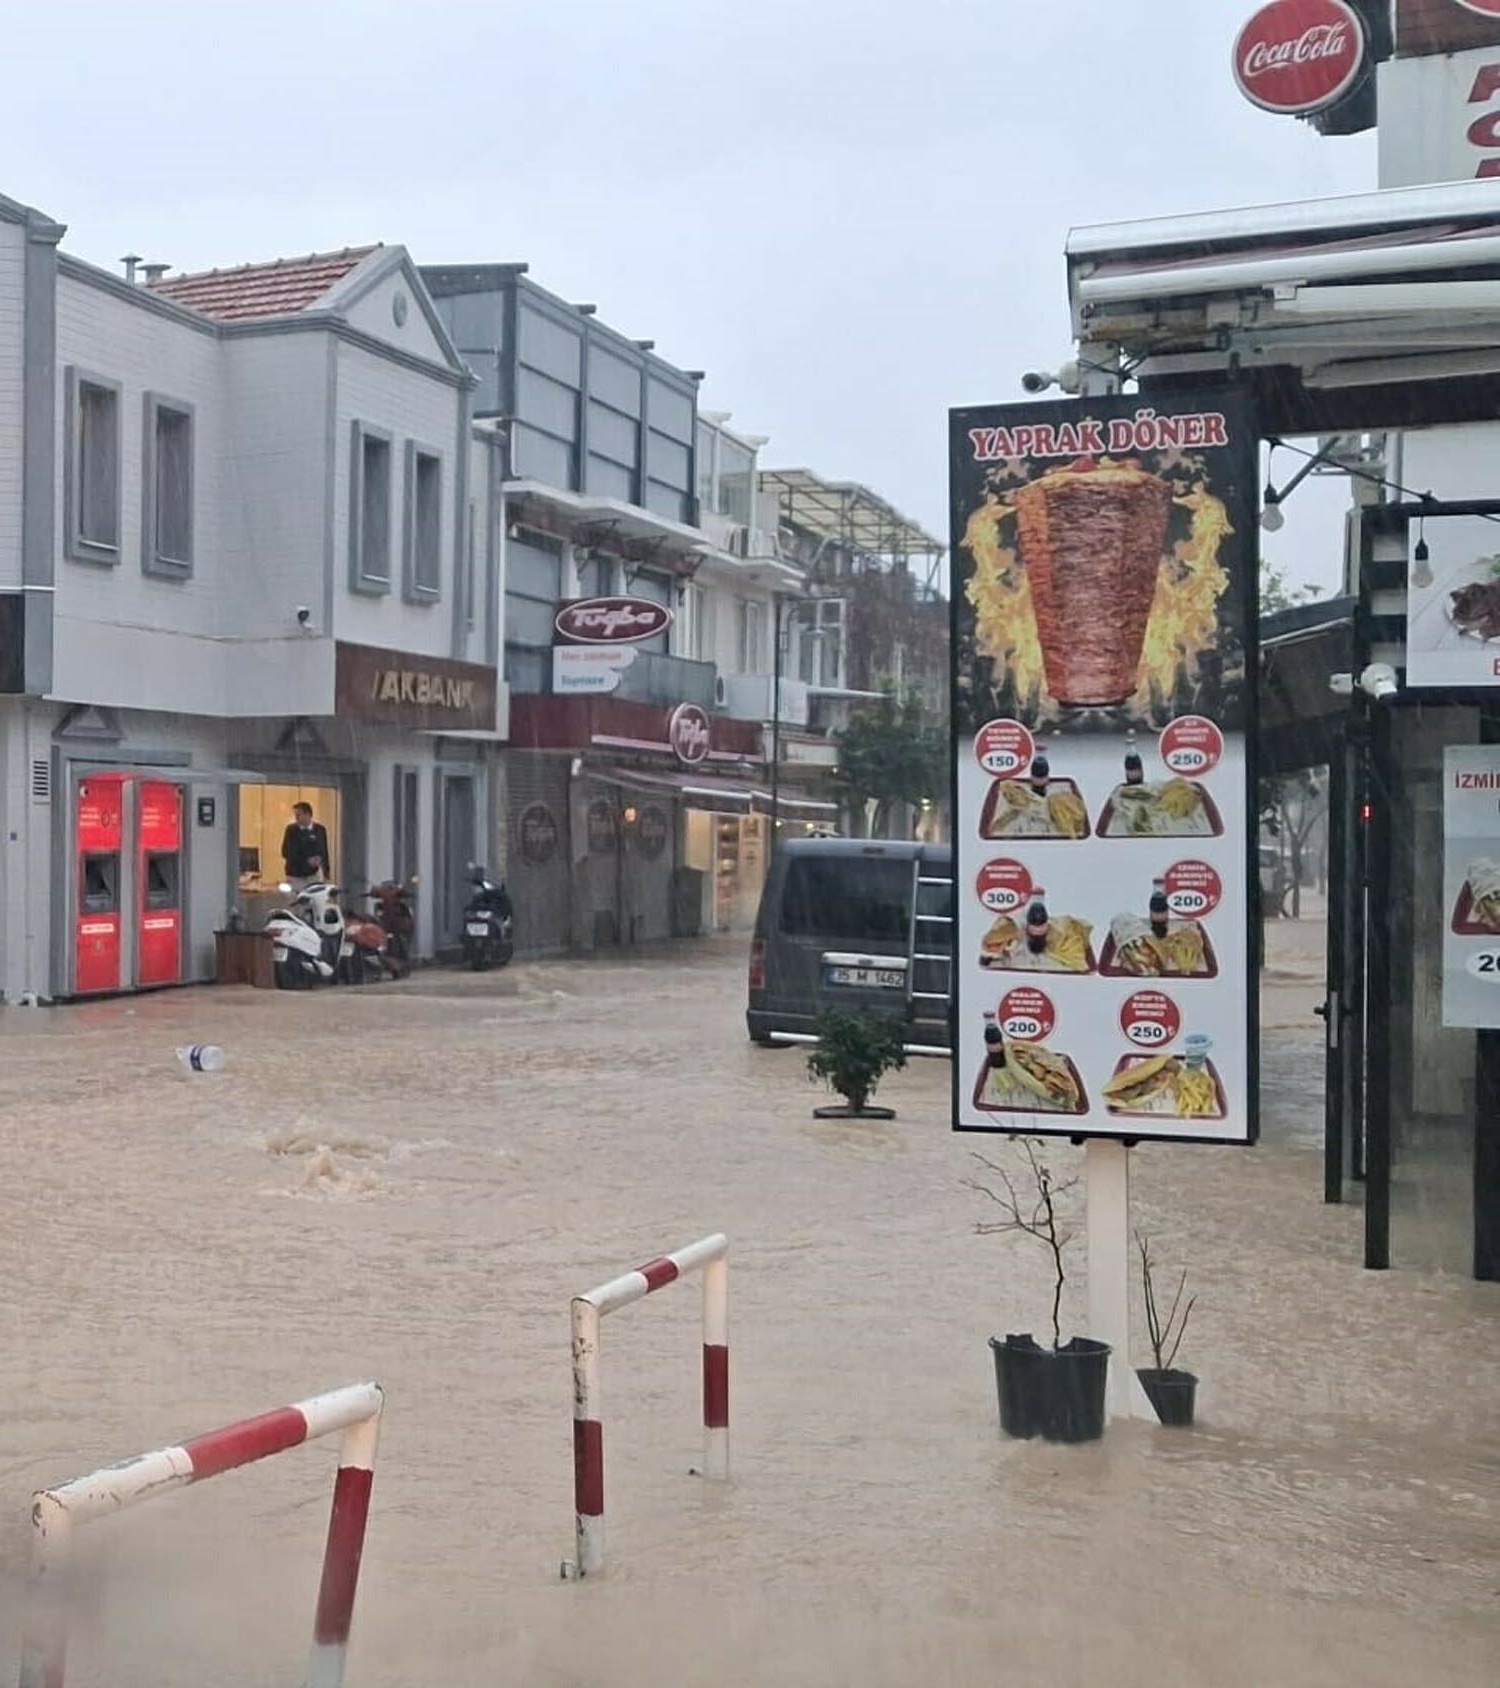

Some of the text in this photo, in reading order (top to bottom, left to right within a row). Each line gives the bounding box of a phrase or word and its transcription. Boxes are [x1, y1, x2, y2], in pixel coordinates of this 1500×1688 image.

[969, 408, 1229, 460] YAPRAK DÖNER
[374, 671, 477, 710] AKBANK
[987, 755, 1014, 767] 150
[1172, 753, 1202, 766] 250
[987, 892, 1015, 904] 300
[1173, 895, 1203, 906] 200
[1478, 953, 1500, 972] 2
[1008, 1021, 1036, 1033] 200
[1132, 1026, 1162, 1038] 250
